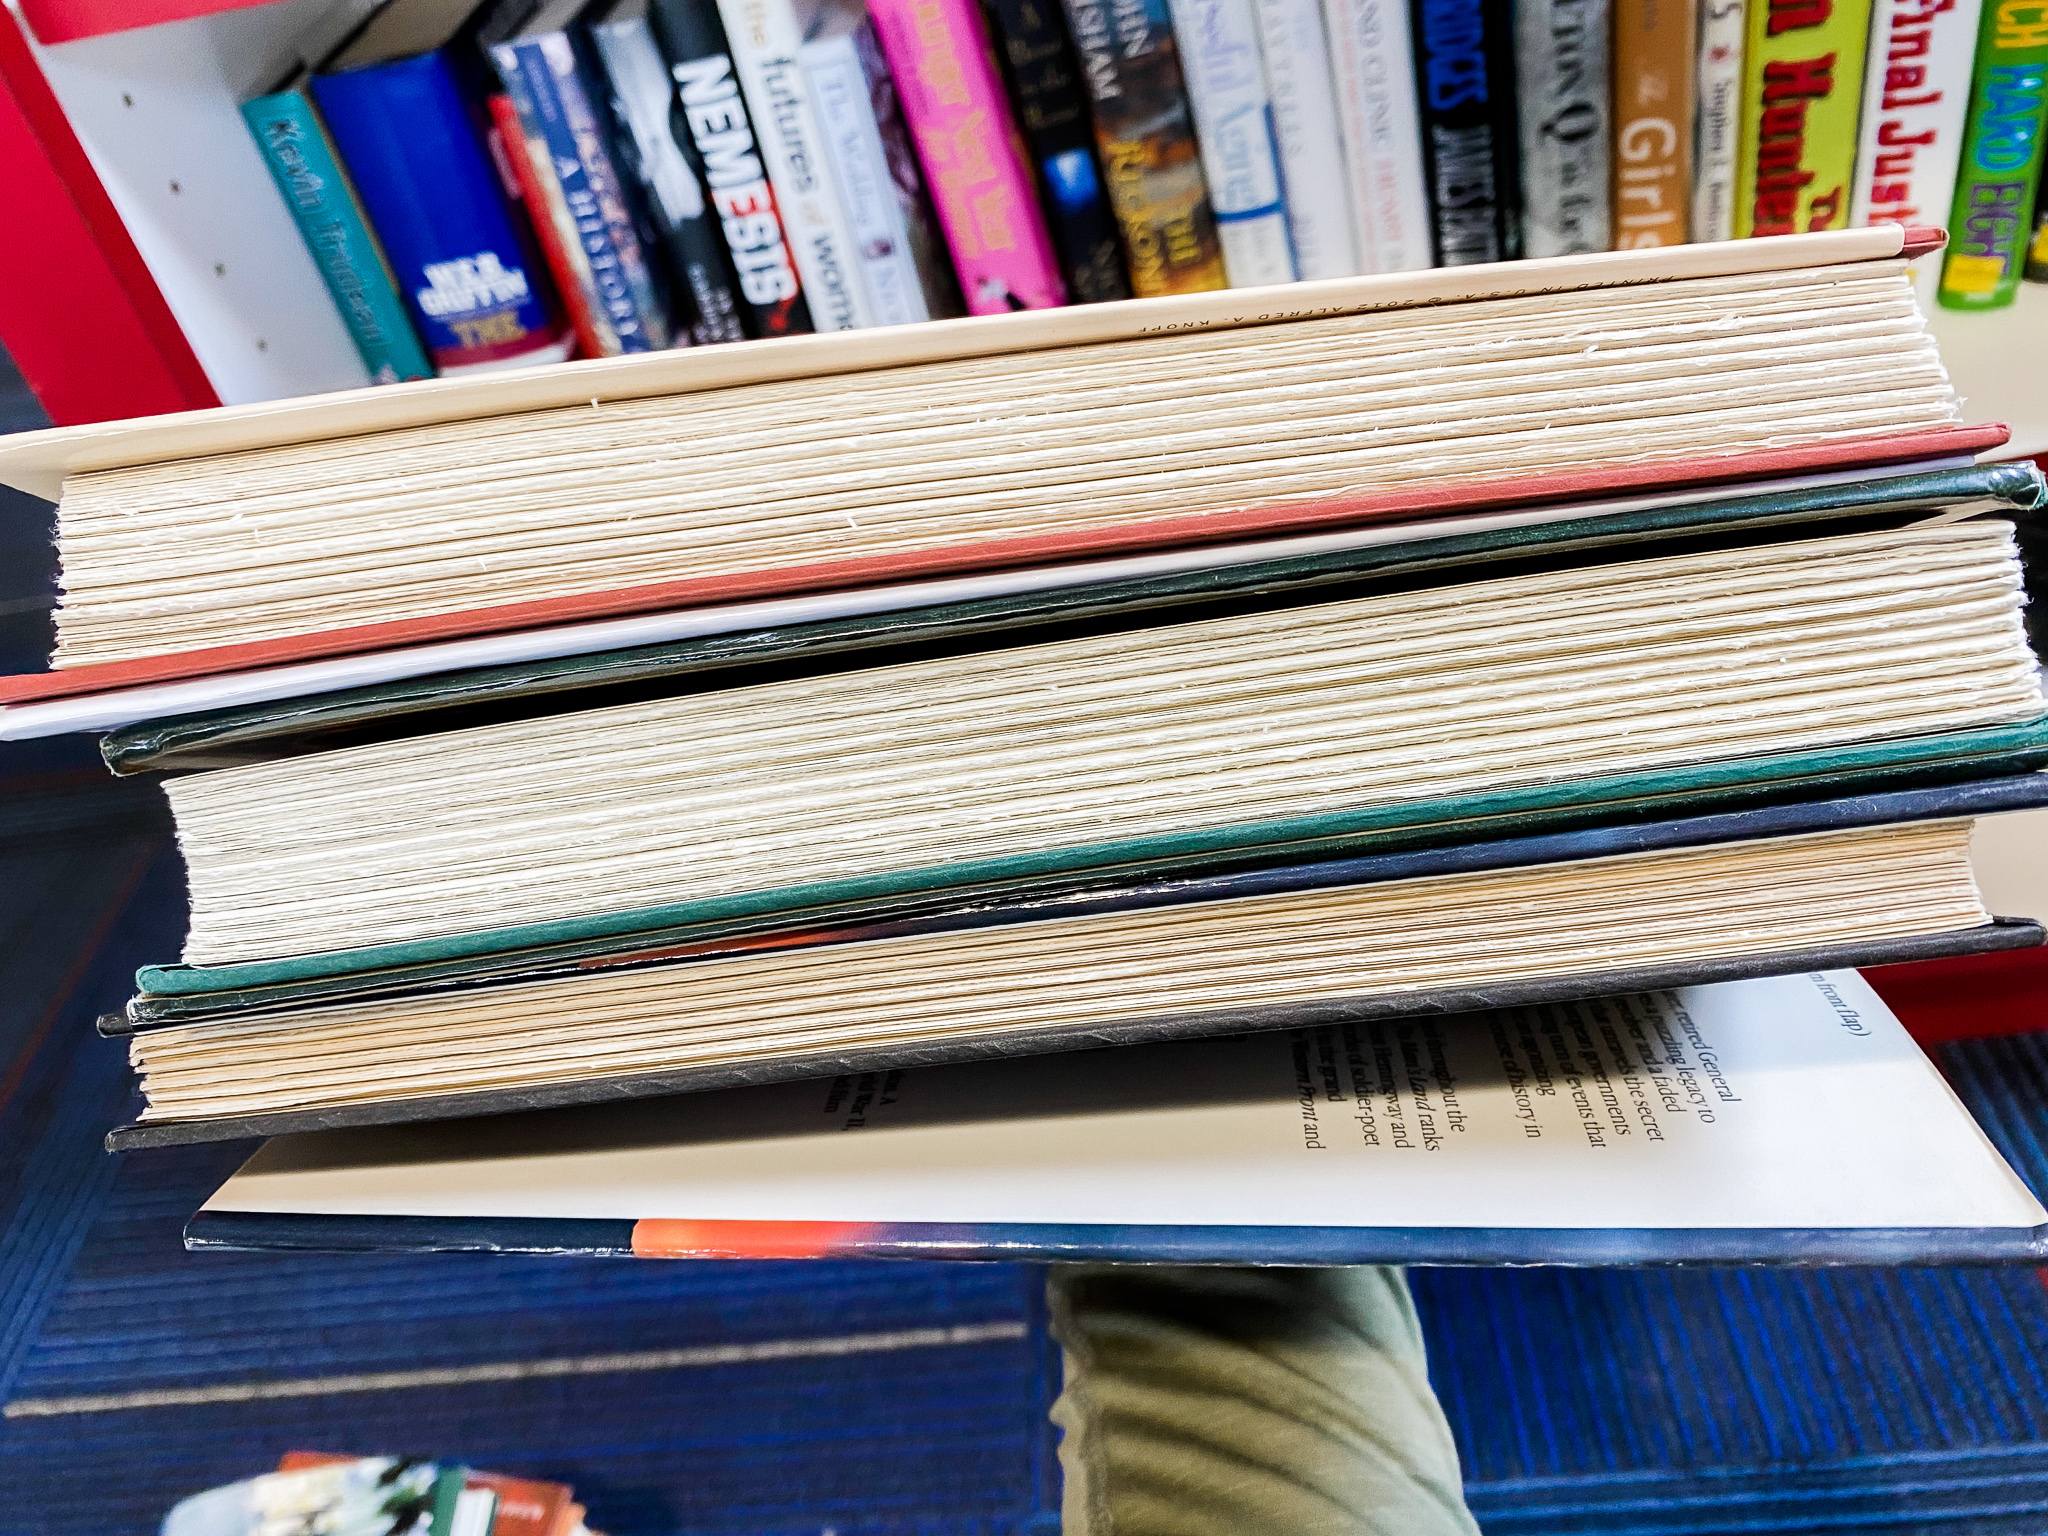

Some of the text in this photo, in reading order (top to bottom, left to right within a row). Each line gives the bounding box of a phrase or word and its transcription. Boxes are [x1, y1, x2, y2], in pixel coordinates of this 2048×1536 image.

[759, 56, 817, 193] futures
[1975, 62, 2048, 174] HARD
[672, 53, 799, 305] NEMESIS
[1619, 117, 1678, 250] Girls
[1139, 320, 1211, 333] KNOPF
[1257, 306, 1344, 322] ALFRED
[1356, 299, 1414, 312] 2012
[1816, 984, 1847, 1008] front
[1836, 1009, 1872, 1037] flap)
[1317, 1064, 1348, 1102] grand
[1425, 1034, 1460, 1107] throughout
[1447, 1108, 1468, 1133] the
[1635, 1042, 1664, 1066] and
[1650, 1076, 1687, 1113] faded
[1643, 1014, 1686, 1066] puzzling
[1675, 1067, 1708, 1108] legacy
[1697, 1109, 1716, 1124] to
[1676, 1011, 1742, 1102] retired General
[1298, 1084, 1319, 1121] Front
[1350, 1066, 1380, 1147] soldier-poet
[1408, 1076, 1437, 1111] Land
[1508, 1072, 1537, 1122] history
[1524, 1124, 1543, 1139] in
[1565, 1076, 1595, 1120] events
[1583, 1120, 1607, 1148] that
[1577, 1050, 1631, 1137] governments
[1623, 1077, 1646, 1098] the
[1303, 1122, 1327, 1150] and
[1390, 1120, 1416, 1150] and
[1418, 1112, 1444, 1152] ranks
[1633, 1099, 1665, 1142] secret
